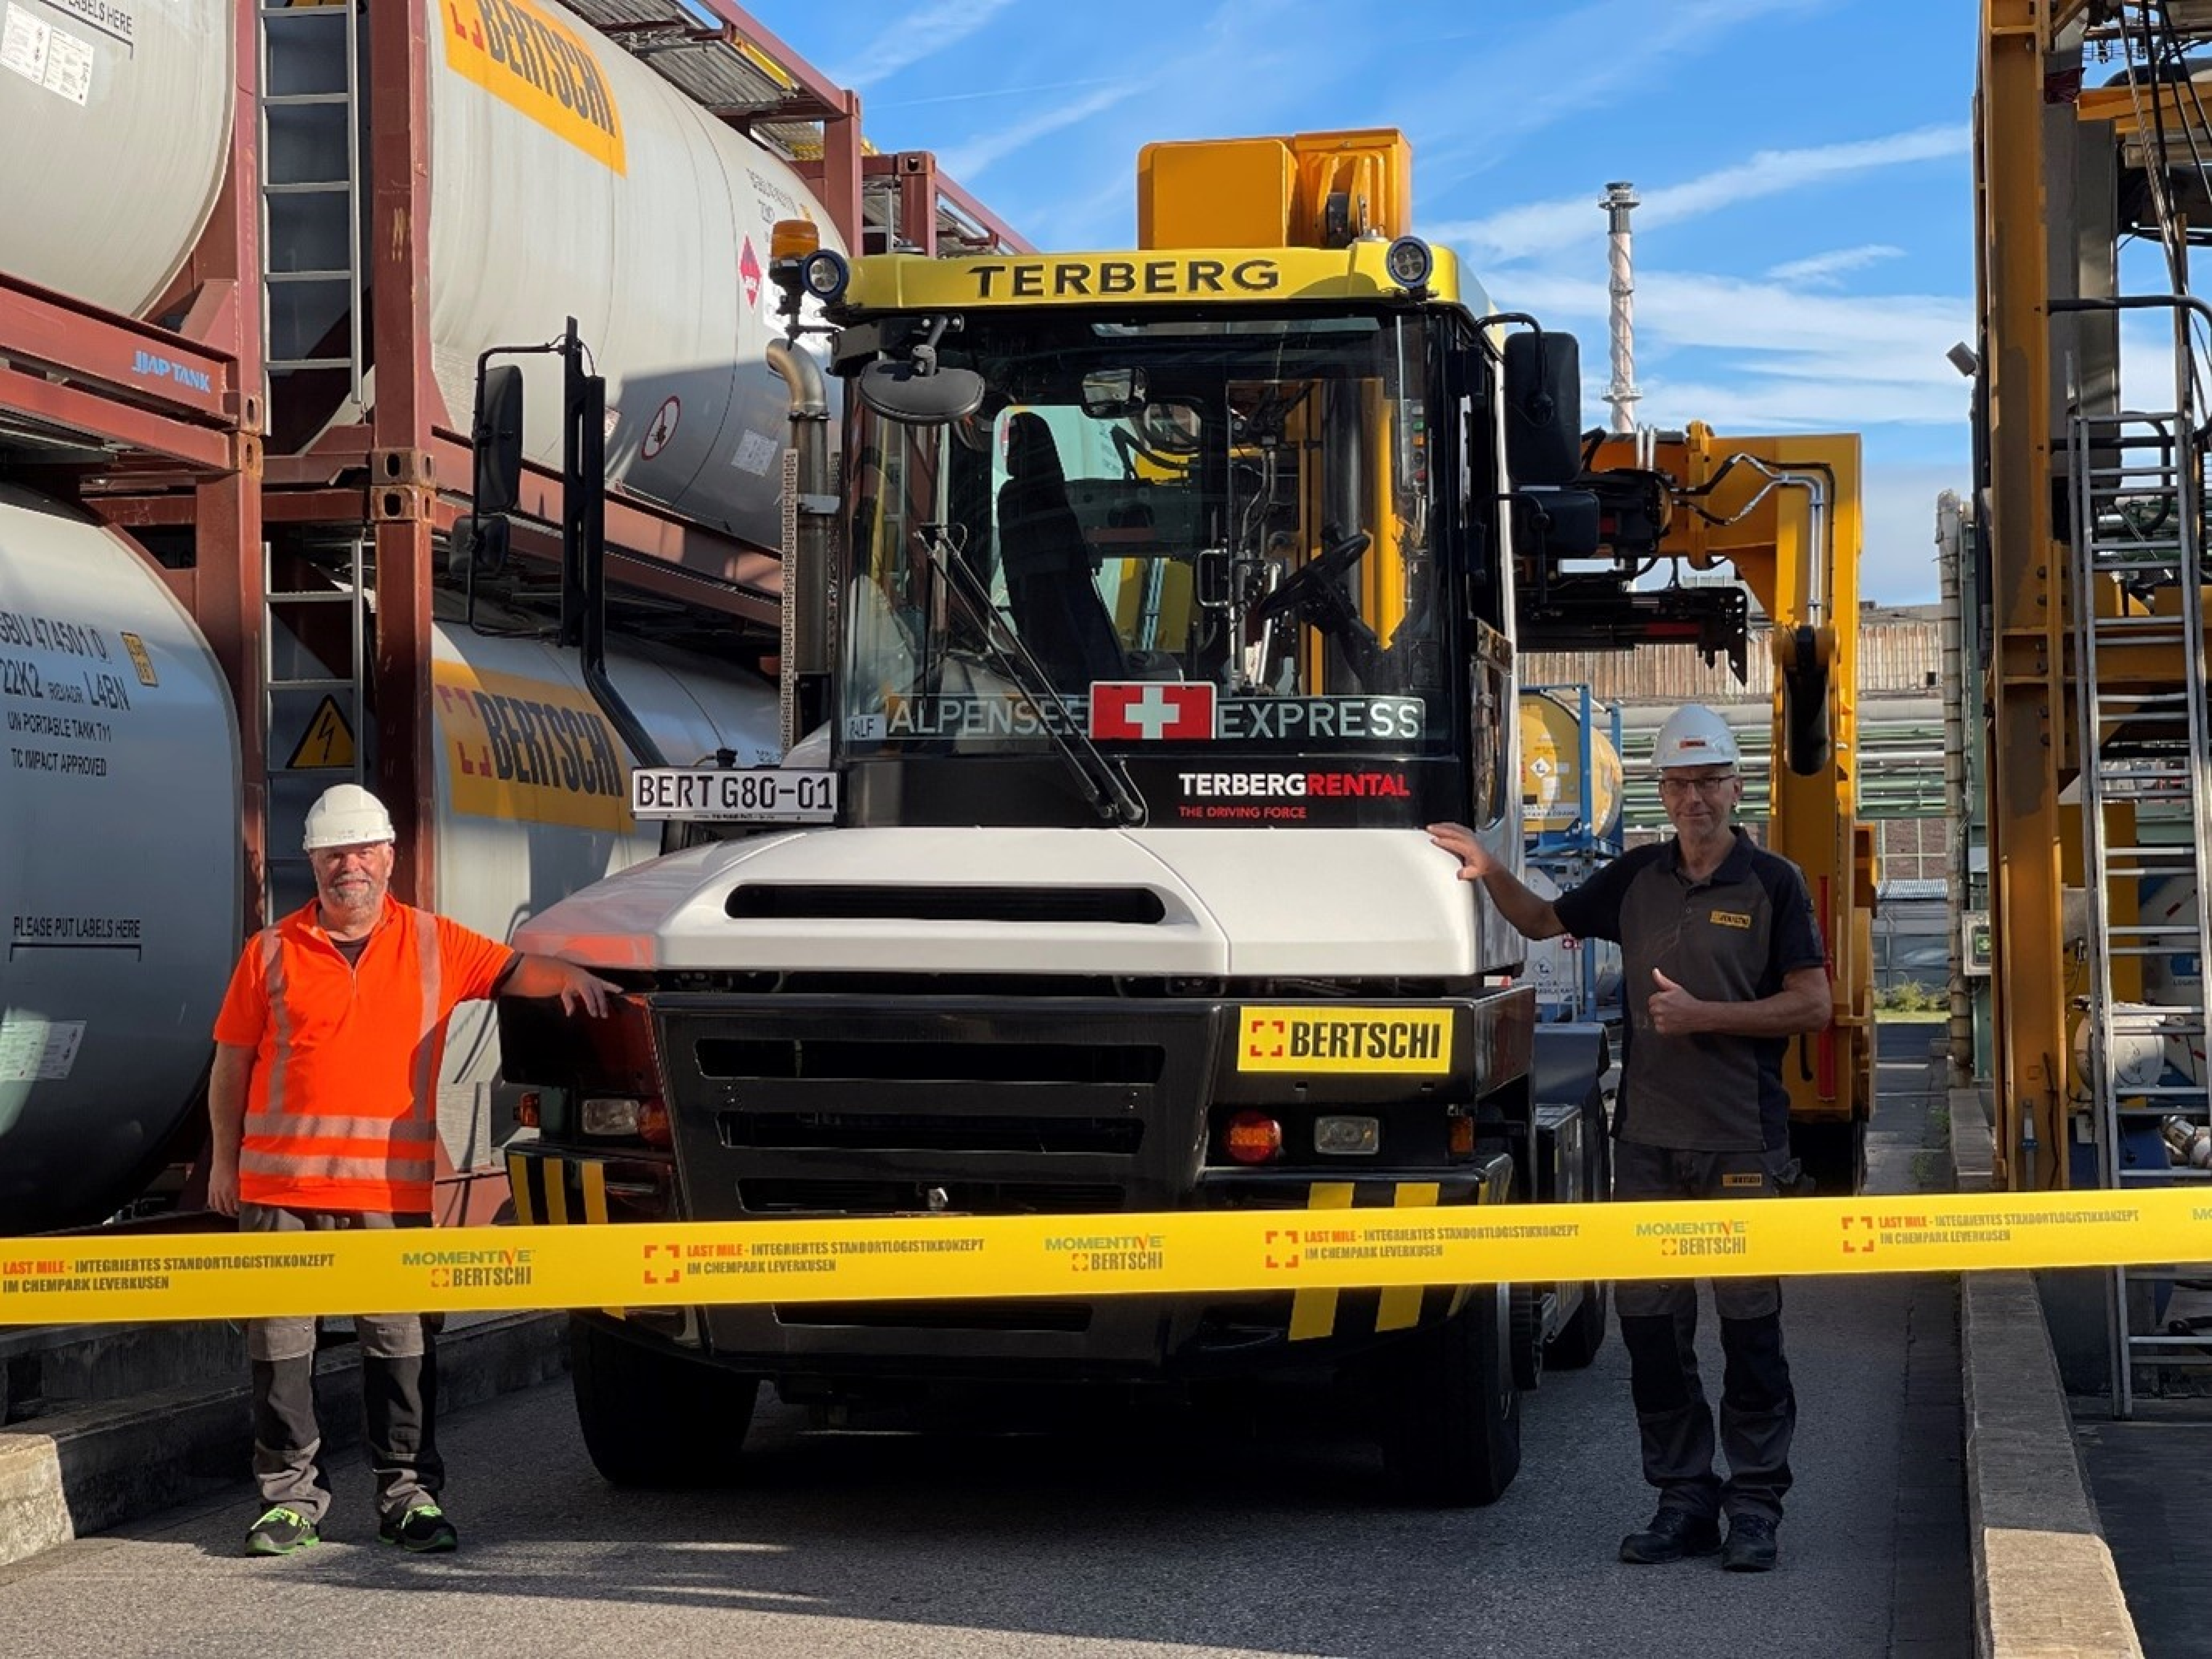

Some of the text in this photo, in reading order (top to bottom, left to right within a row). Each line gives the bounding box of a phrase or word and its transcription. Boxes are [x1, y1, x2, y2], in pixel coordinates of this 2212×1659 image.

[107, 6, 132, 35] HERE
[476, 0, 616, 138] BERTSCHI
[968, 259, 1279, 298] TERBERG
[172, 362, 210, 393] TANK
[83, 671, 130, 711] L4BN
[8, 711, 21, 732] UN
[22, 712, 71, 738] PORTABLE
[72, 720, 96, 741] TANK
[889, 700, 1089, 734] ALPENSEE
[1217, 701, 1419, 738] EXPRESS
[471, 690, 624, 798] BERTSCHI
[11, 747, 106, 777] TC IMPACT APPROVED
[639, 776, 833, 809] BERT G80-01
[1179, 806, 1307, 819] THE DRIVING FORCE
[14, 916, 140, 937] PLEASE PUT LABELS HERE
[1291, 1021, 1441, 1058] BERTSCHI
[1636, 1221, 1746, 1236] MOMENTIVE
[1879, 1216, 1902, 1228] LAST
[1905, 1216, 1927, 1227] MILE
[1935, 1214, 2003, 1226] INTEGRIERTES
[1045, 1235, 1162, 1251] MOMENTIVE
[1305, 1231, 1328, 1242] LAST
[1332, 1231, 1356, 1242] MILE
[1364, 1228, 1435, 1241] INTEGRIERTES
[1880, 1229, 2010, 1244] IM CHEMPARK LEVERKUSEN
[687, 1244, 714, 1257] LAST
[717, 1244, 742, 1256] MILE
[752, 1242, 829, 1256] INTEGRIERTES
[831, 1238, 985, 1254] STANDORTLOGISTIKKONZEPT
[1305, 1245, 1443, 1259] IM CHEMPARK LEVERKUSEN
[1680, 1237, 1746, 1255] BERTSCHI
[3, 1260, 32, 1275] LAST
[36, 1260, 65, 1274] MILE
[75, 1257, 161, 1273] INTEGRIERTES
[163, 1253, 335, 1270] STANDORTLOGISTIKKONZEPT
[402, 1249, 531, 1266] MOMENTIVE
[687, 1259, 836, 1275] IM CHEMPARK LEVERKUSEN
[1091, 1251, 1163, 1271] BERTSCHI
[3, 1276, 170, 1293] IM CHEMPARK LEVERKUSEN
[453, 1266, 531, 1287] BERTSCHI
